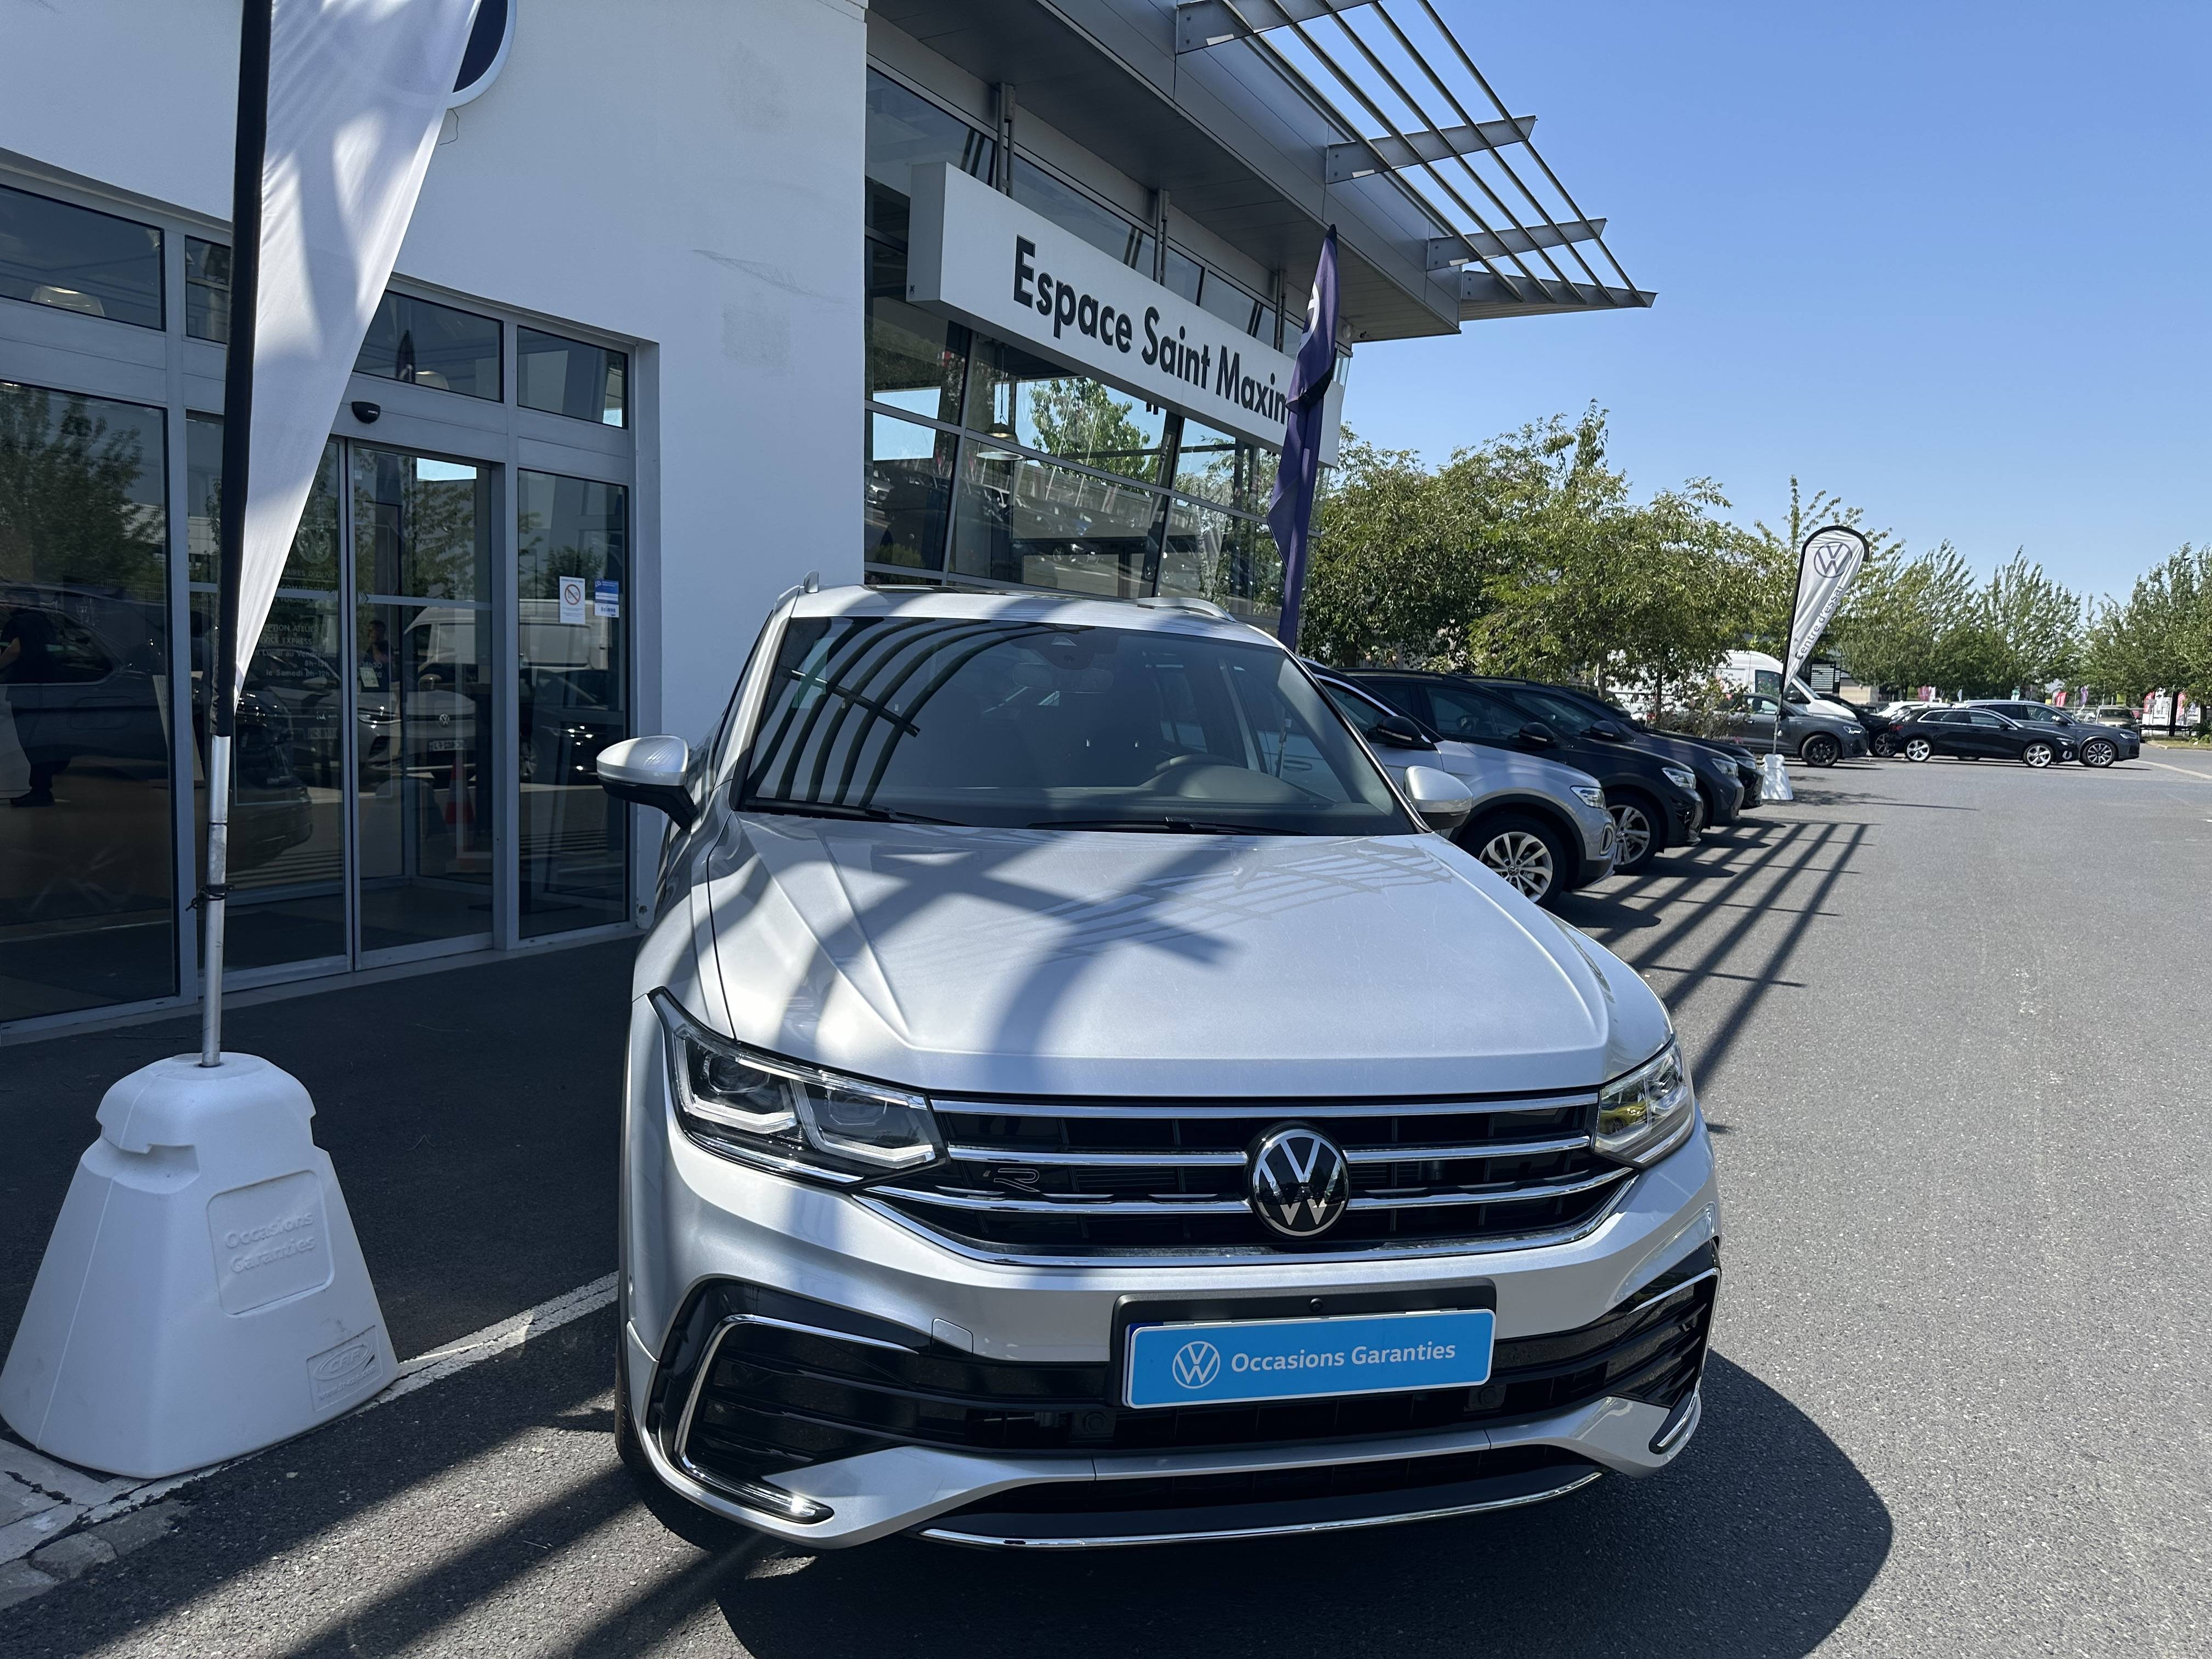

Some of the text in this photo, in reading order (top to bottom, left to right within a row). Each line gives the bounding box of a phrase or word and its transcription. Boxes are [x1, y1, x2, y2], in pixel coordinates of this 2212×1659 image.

[1013, 235, 1132, 353] Espace
[1142, 306, 1210, 389] Saint
[1795, 624, 1820, 660] Centre
[276, 669, 303, 677] Samedi
[1253, 1128, 1349, 1236] VW
[225, 1211, 314, 1248] Occasions
[230, 1237, 316, 1273] Garanties
[1231, 1348, 1345, 1373] Occasions
[1351, 1341, 1456, 1366] Garanties
